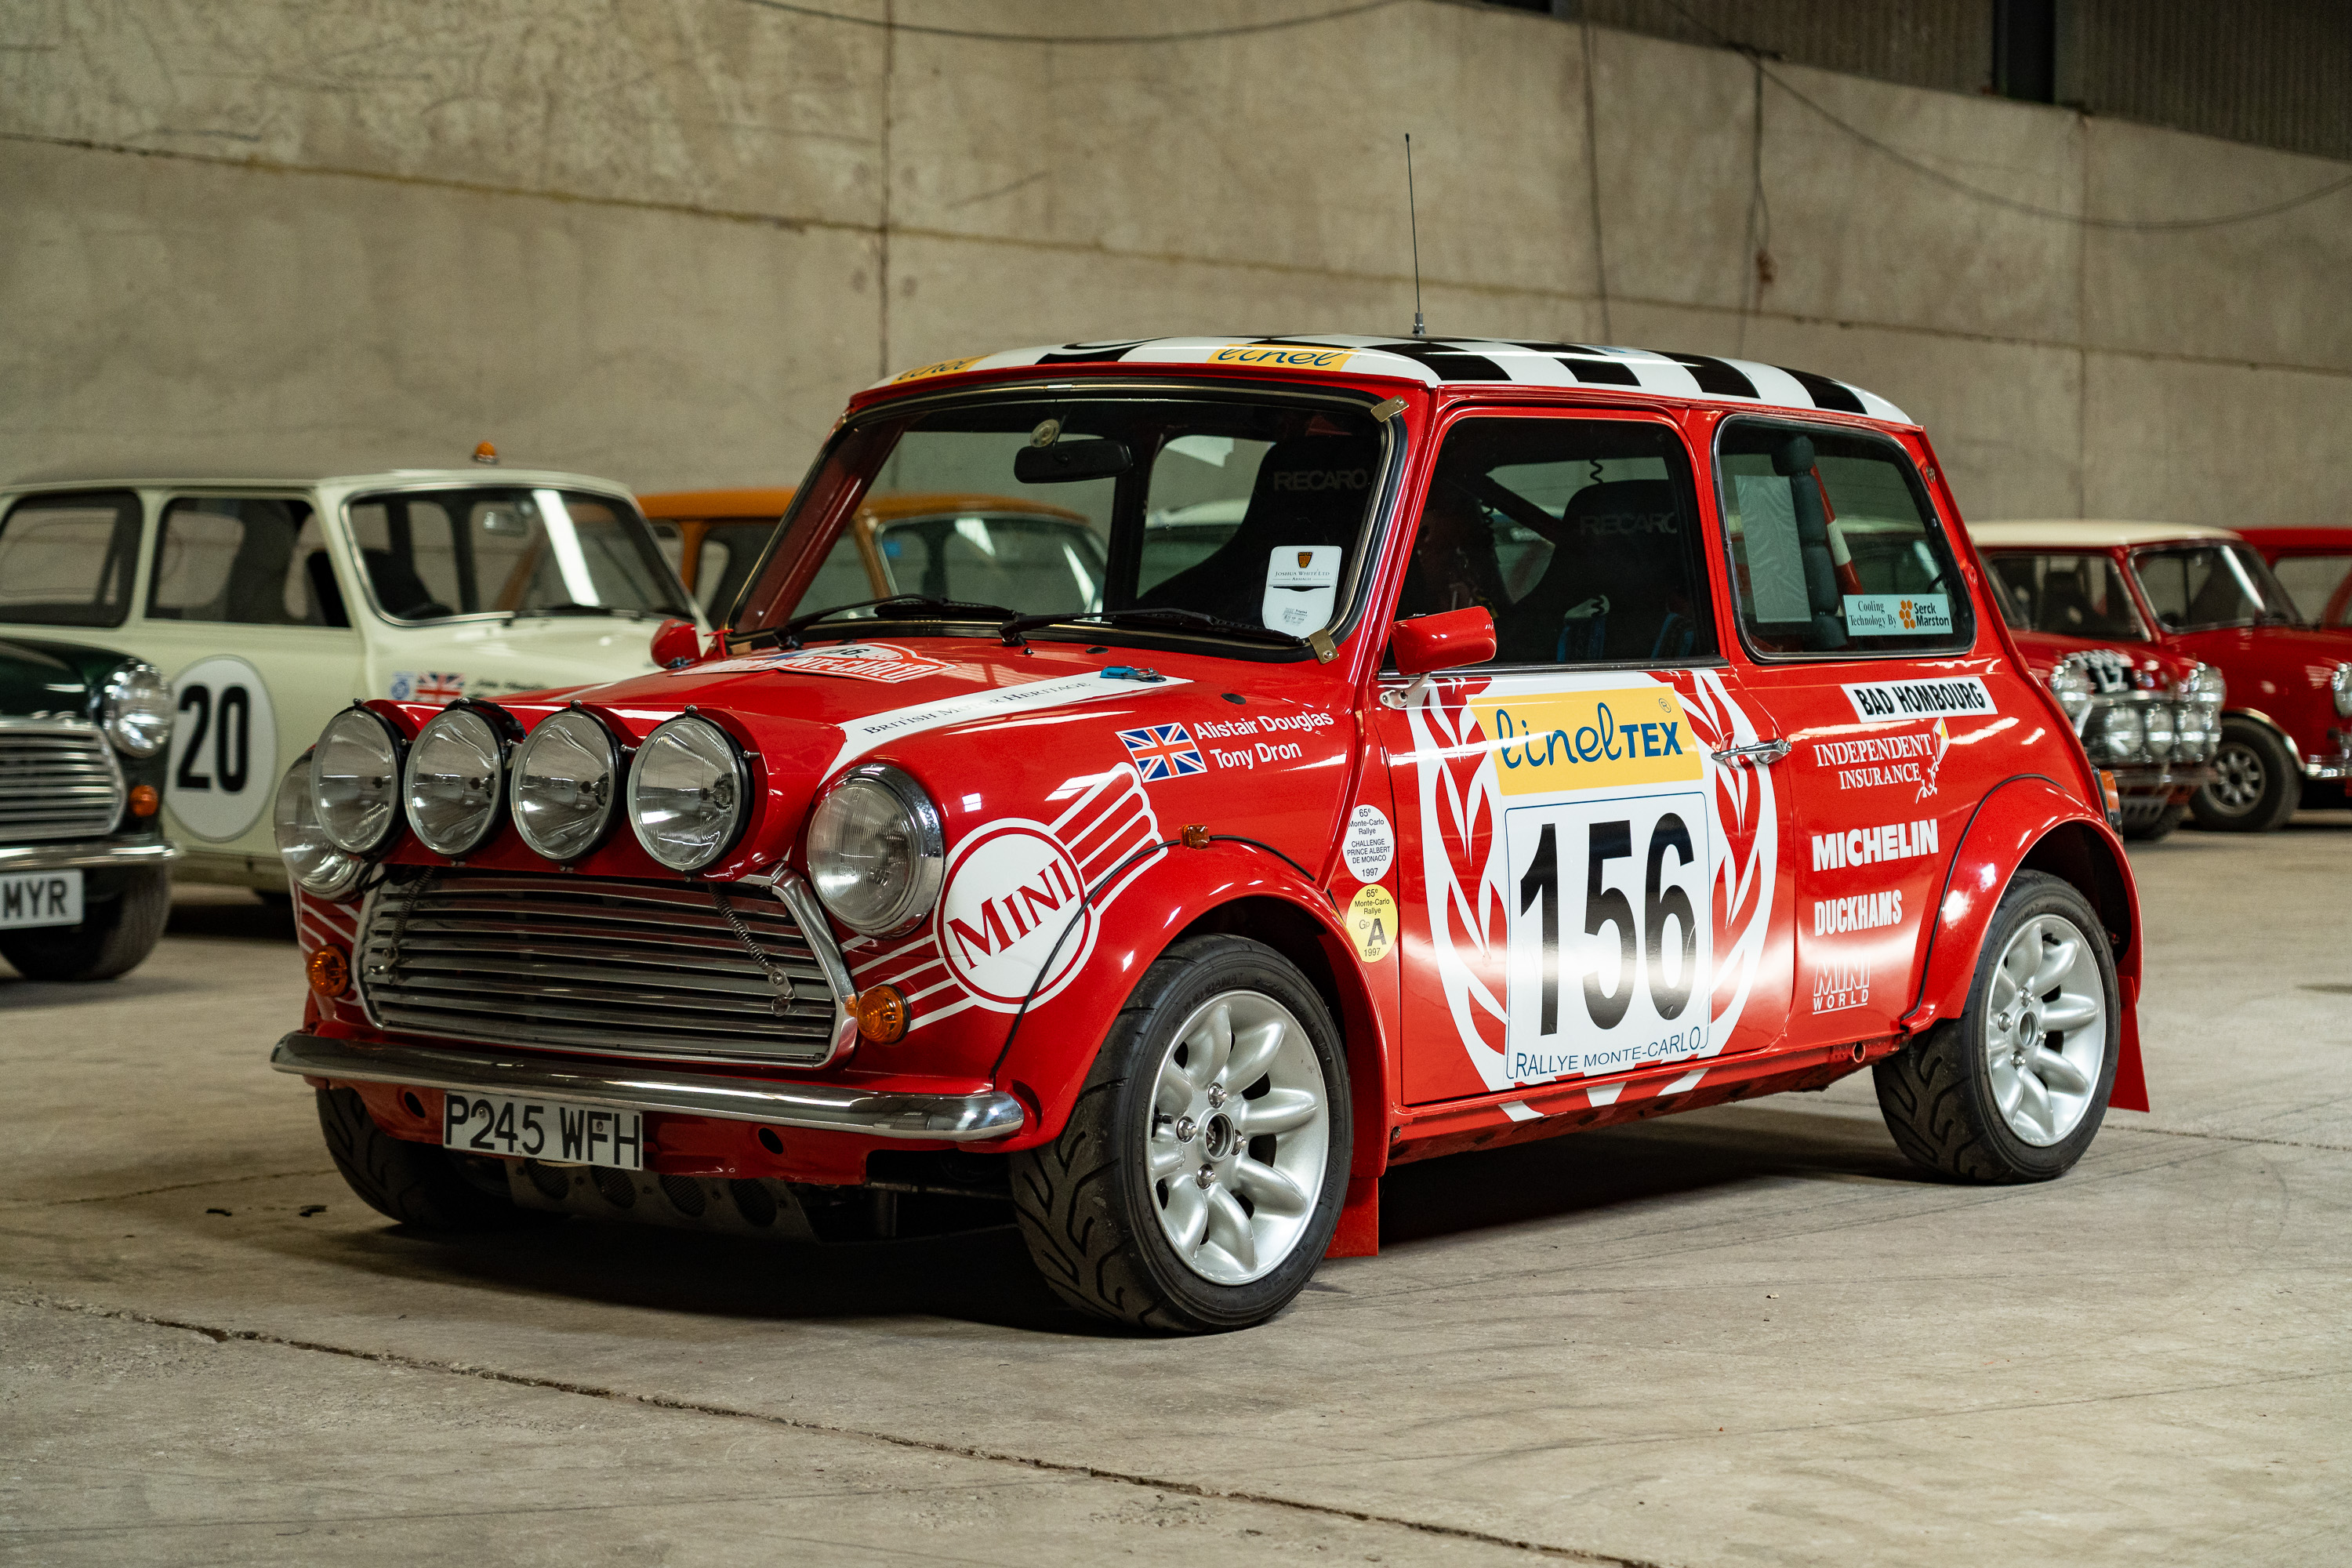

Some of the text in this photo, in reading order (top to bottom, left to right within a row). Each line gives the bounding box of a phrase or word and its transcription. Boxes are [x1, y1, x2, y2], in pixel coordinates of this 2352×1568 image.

[1273, 467, 1367, 492] RECARO
[1857, 601, 1885, 614] Cooling
[1914, 602, 1936, 615] Serck
[1916, 615, 1950, 627] Marston
[1849, 615, 1897, 629] Technology By
[862, 713, 938, 734] BRITISH
[1000, 682, 1091, 702] HERITAGE
[1854, 684, 1987, 717] BAD HOMBOURG
[176, 684, 251, 793] 20
[1192, 711, 1334, 740] Alistair Douglas
[1209, 742, 1303, 770] Tony Dron
[1813, 733, 1933, 768] INDEPENDENT
[1838, 763, 1922, 790] INSURANCE
[1348, 818, 1385, 827] Monte-Carlo
[1347, 846, 1391, 856] PRINCE ALBERT
[1352, 839, 1385, 848] CHALLENGE
[1812, 818, 1940, 872] MICHELIN
[1361, 855, 1386, 863] MONACO
[1362, 868, 1378, 877] 1997
[3, 878, 67, 918] MYR
[1355, 898, 1390, 907] Monte-Carlo
[946, 858, 1076, 971] MINI
[1520, 812, 1697, 1036] 156
[1814, 890, 1903, 937] DUCKHAMS
[1359, 918, 1387, 947] Gp A
[1364, 948, 1381, 956] 1997
[1813, 953, 1871, 997] MINI
[1813, 989, 1869, 1011] WORLD
[1515, 1026, 1702, 1078] RALLYE MONTE-CARLO
[445, 1094, 640, 1168] P245 WFH
